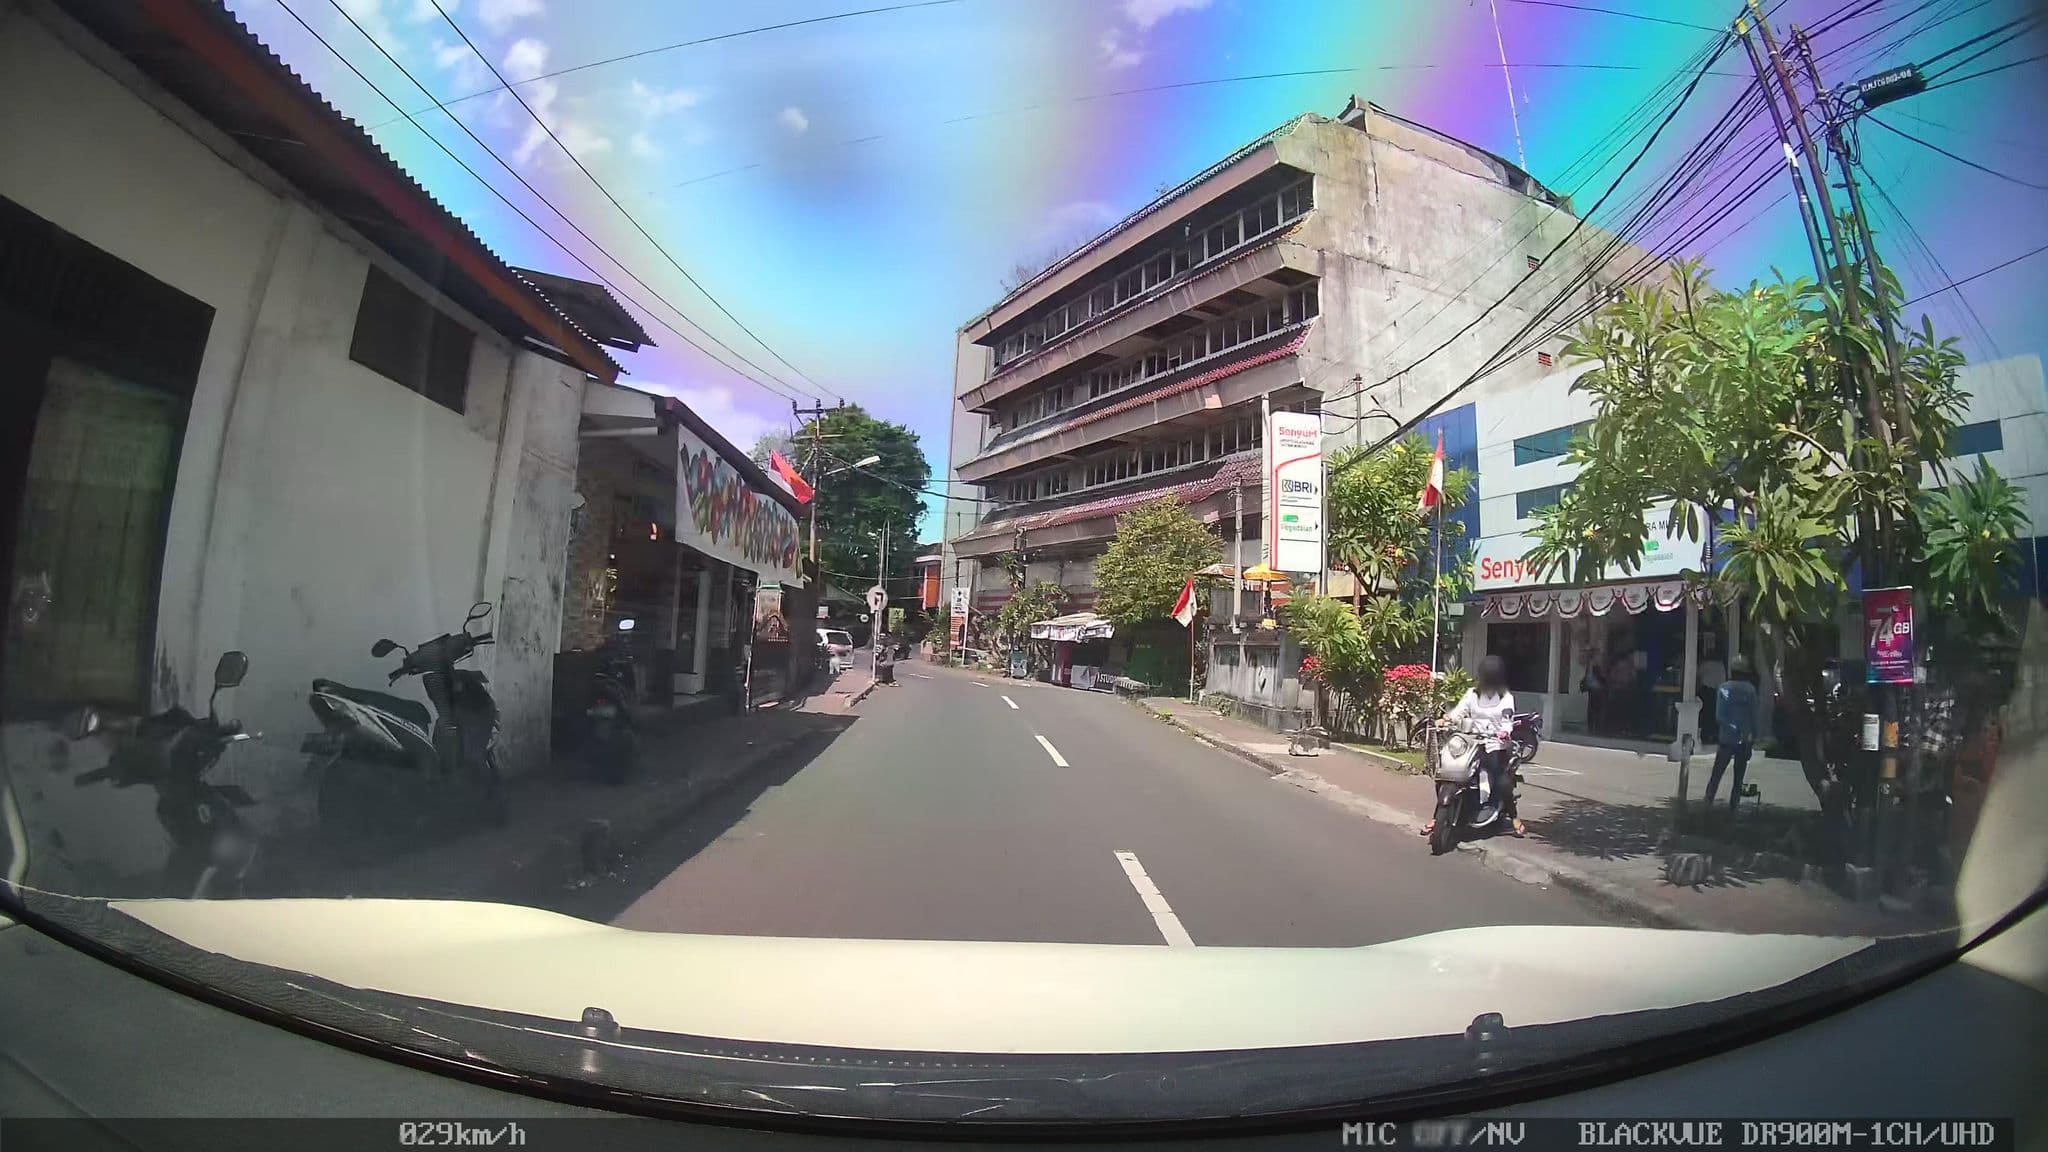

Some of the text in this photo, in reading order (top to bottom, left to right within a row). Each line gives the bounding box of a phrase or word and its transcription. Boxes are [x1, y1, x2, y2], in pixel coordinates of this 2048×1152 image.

[1294, 480, 1313, 493] BRI
[1870, 617, 1910, 648] 74 GB
